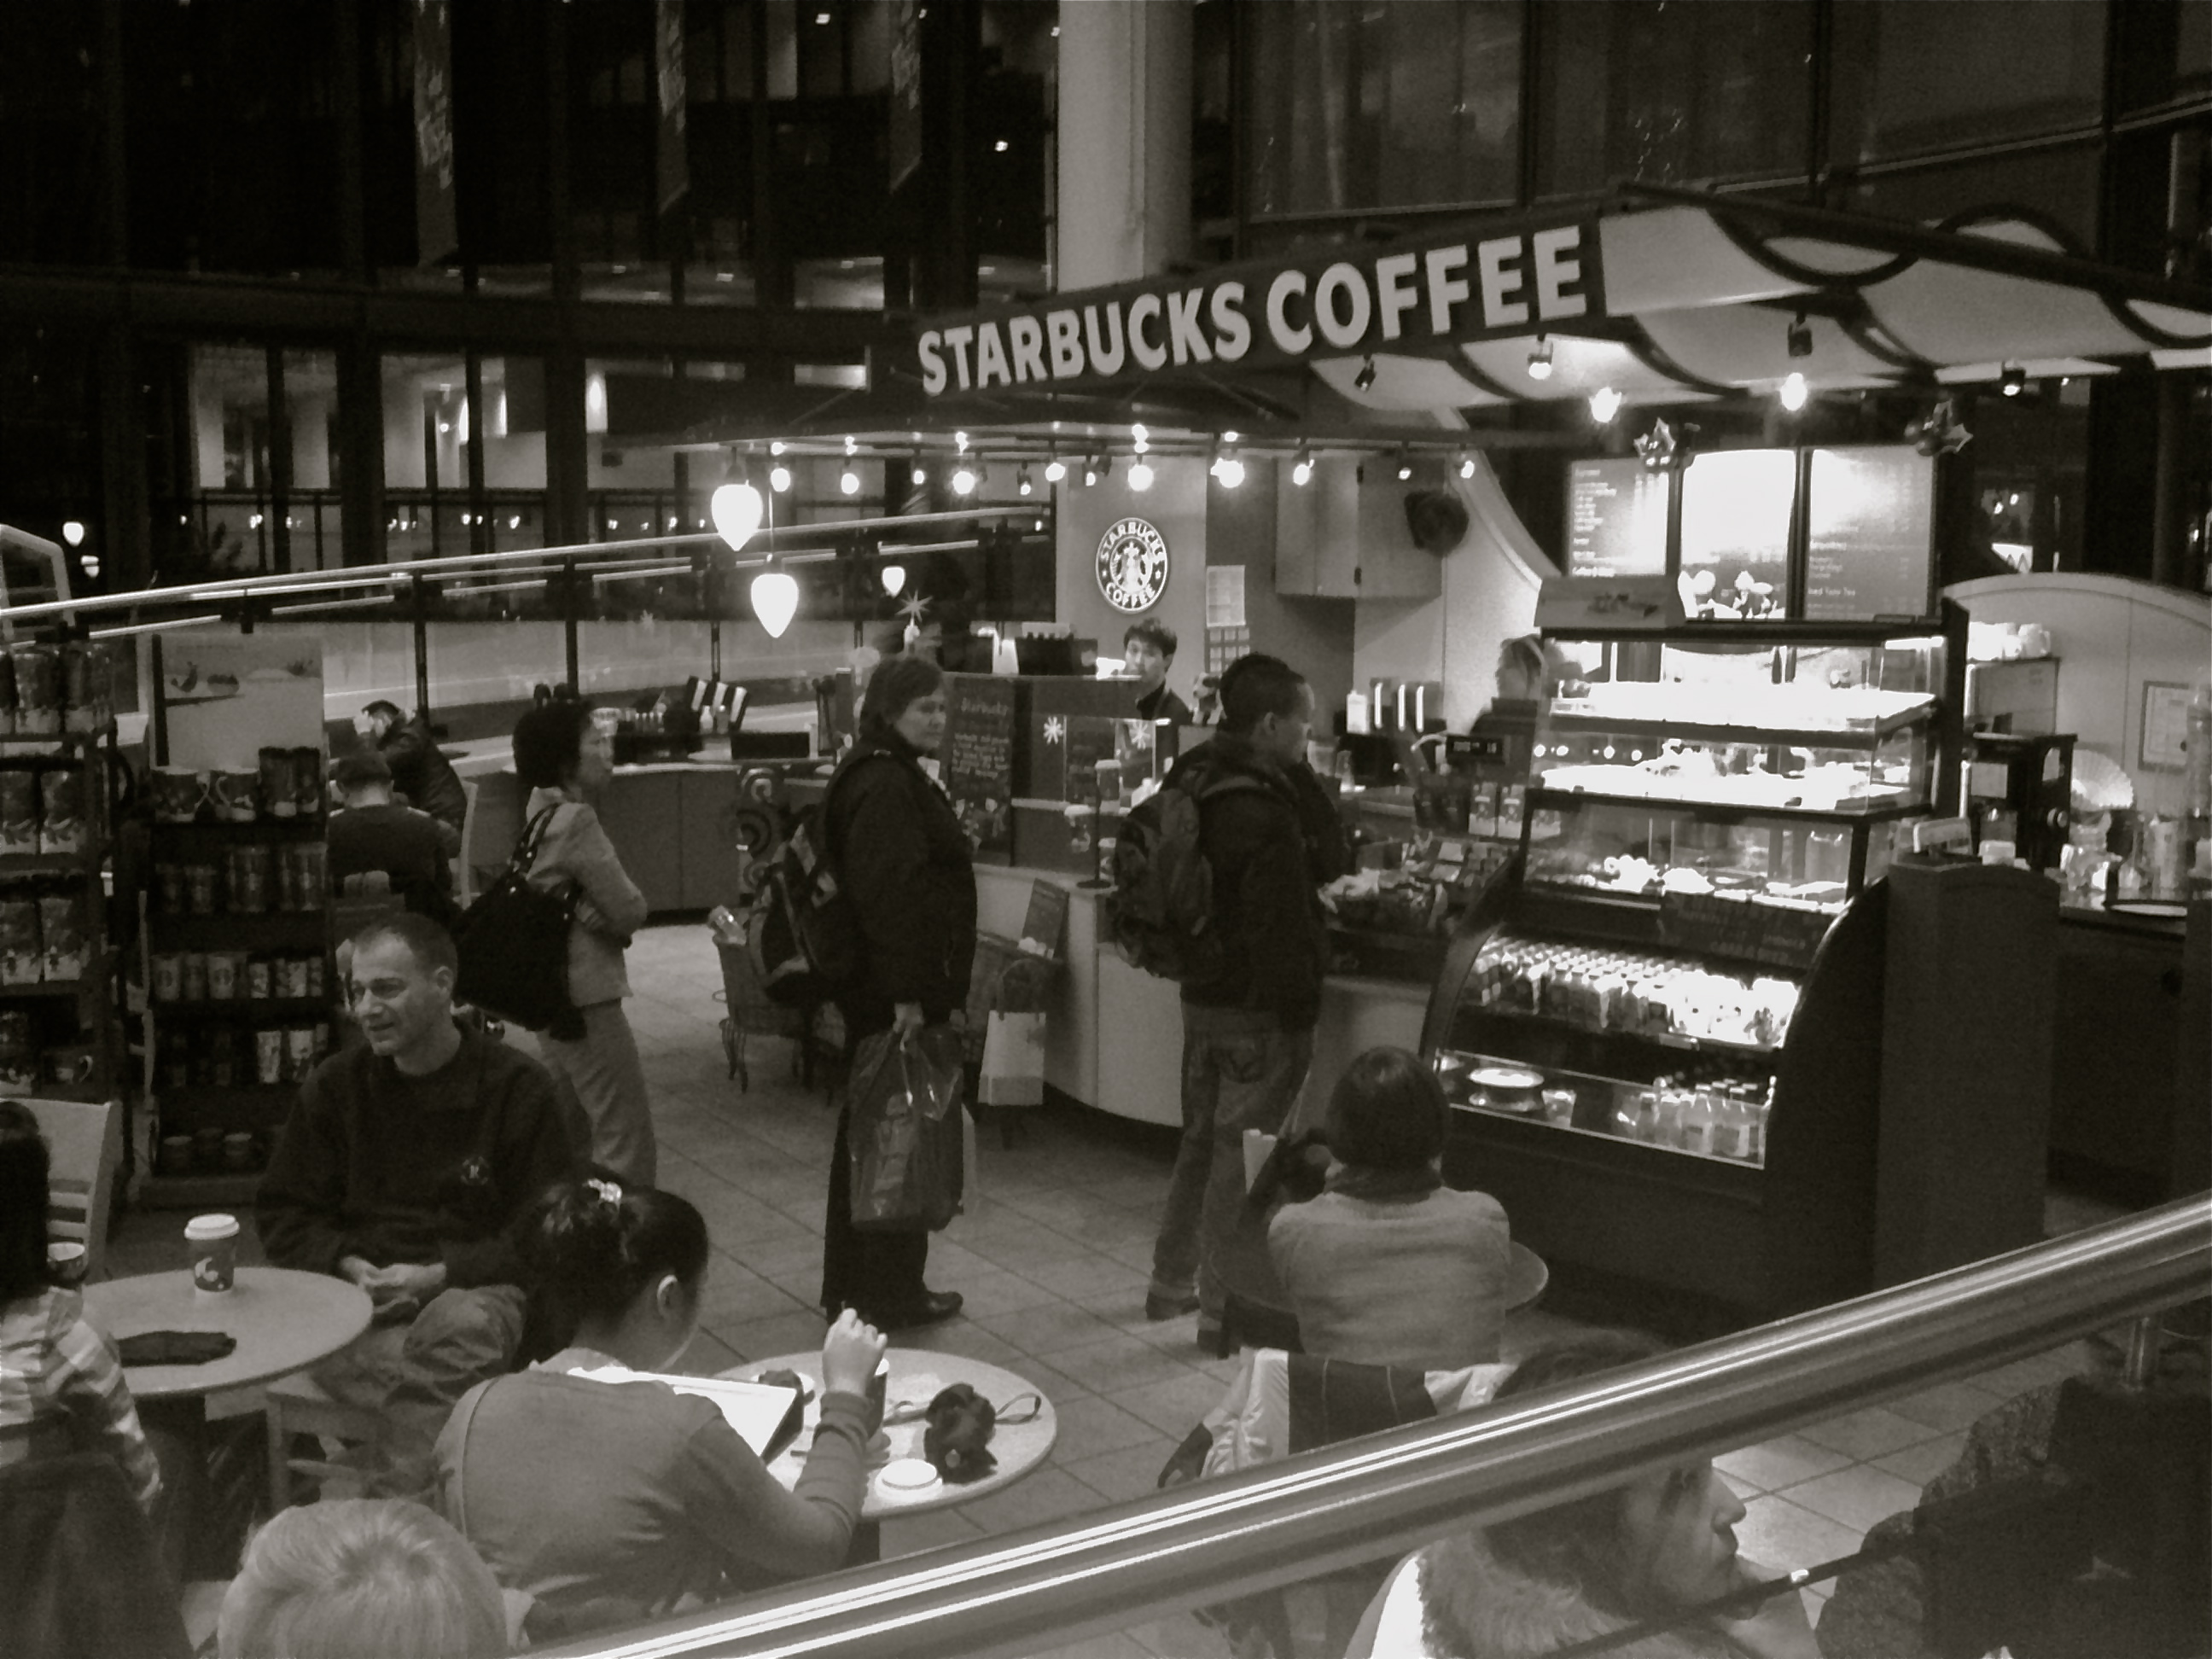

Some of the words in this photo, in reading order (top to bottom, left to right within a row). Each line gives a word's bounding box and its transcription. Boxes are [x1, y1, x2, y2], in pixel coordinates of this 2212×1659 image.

[917, 280, 1252, 398] STARBUCKS
[1266, 225, 1587, 354] COFFEE
[1101, 521, 1165, 564] STARBUCKS
[1106, 583, 1155, 607] COFFEE
